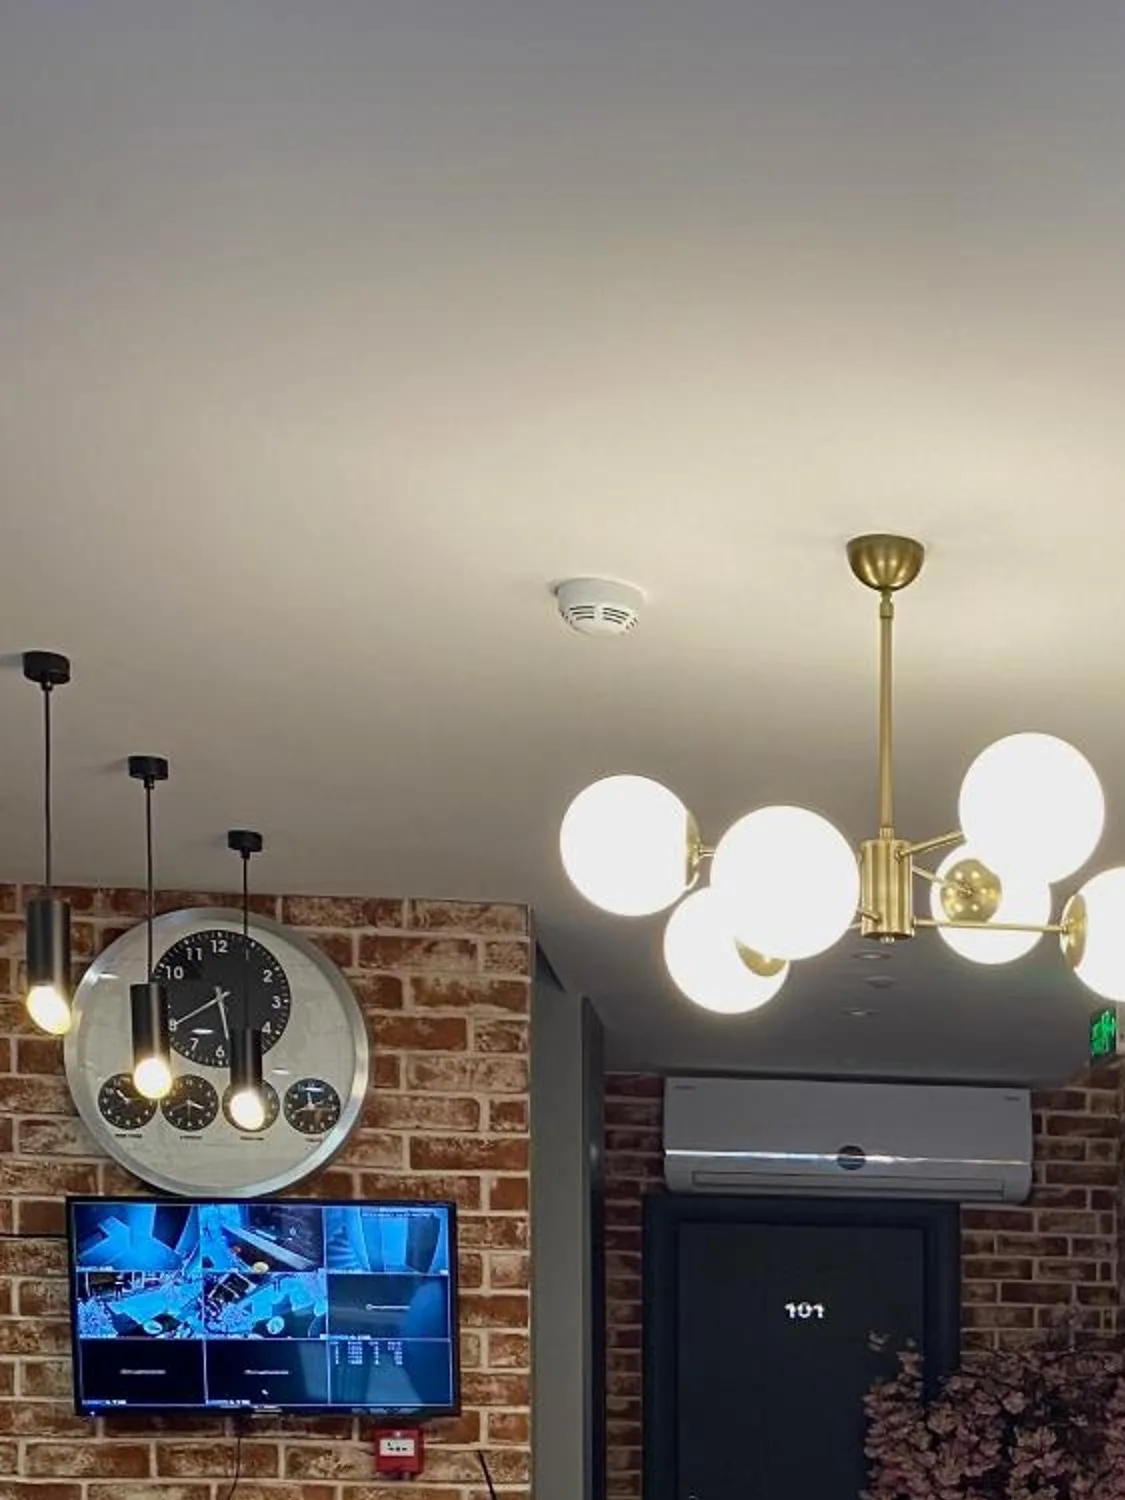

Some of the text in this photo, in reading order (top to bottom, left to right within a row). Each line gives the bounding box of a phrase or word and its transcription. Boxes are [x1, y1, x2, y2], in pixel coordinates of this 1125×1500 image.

[186, 947, 202, 960] 11
[210, 940, 228, 953] 12
[165, 965, 184, 979] 10
[263, 969, 273, 983] 2
[271, 995, 281, 1009] 3
[262, 1021, 272, 1034] 4
[190, 1037, 199, 1051] 7
[215, 1045, 225, 1058] 6
[784, 1302, 825, 1318] 101
